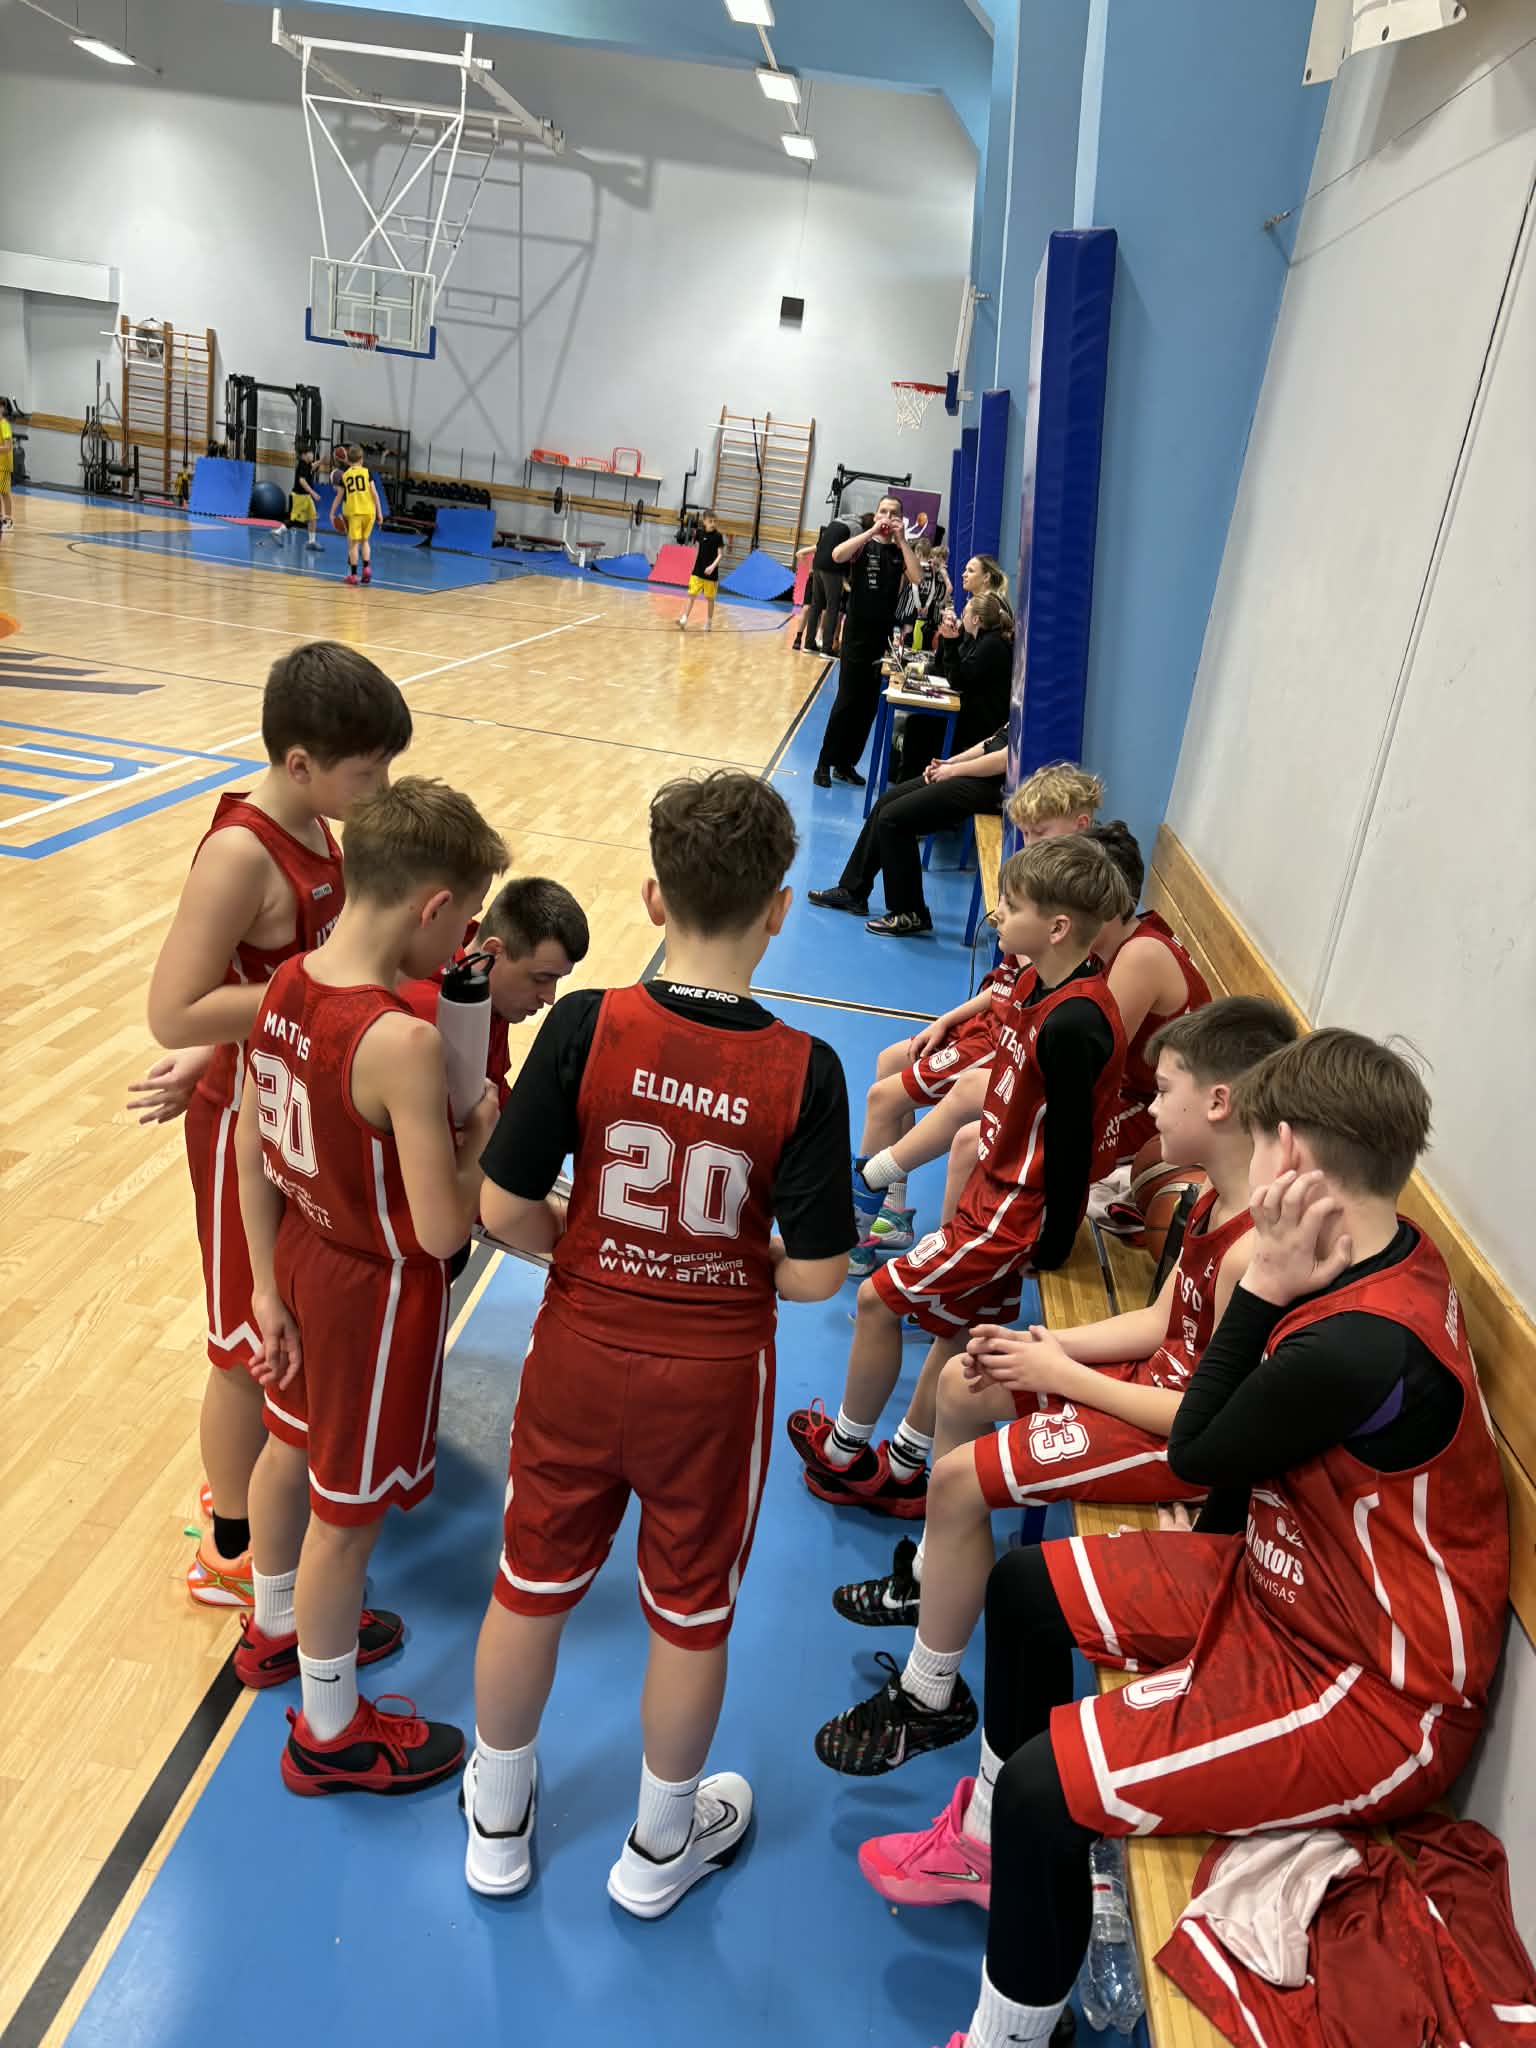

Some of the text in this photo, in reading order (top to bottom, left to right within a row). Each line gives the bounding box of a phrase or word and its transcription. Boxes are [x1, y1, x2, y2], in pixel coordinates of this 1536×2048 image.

[346, 475, 366, 493] 20
[668, 984, 739, 1004] NIKE PRO
[263, 1010, 311, 1061] MATIS
[250, 1048, 319, 1178] 30
[632, 1068, 749, 1126] ELDARAS
[598, 1119, 754, 1239] 20
[598, 1254, 749, 1286] www.ark.lt
